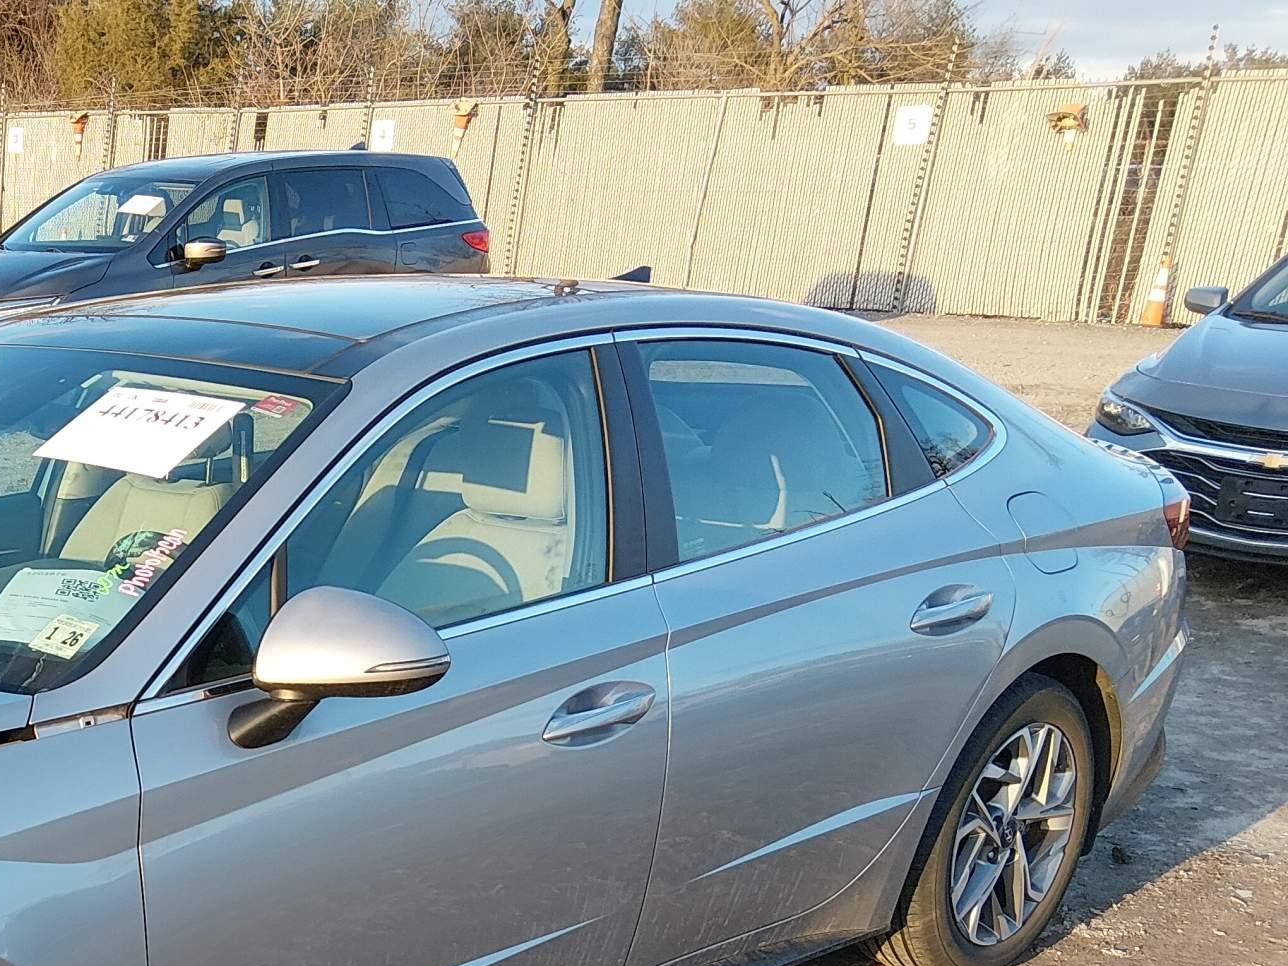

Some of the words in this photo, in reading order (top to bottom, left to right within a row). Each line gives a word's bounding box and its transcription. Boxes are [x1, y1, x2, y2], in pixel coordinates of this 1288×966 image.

[907, 118, 917, 130] 5
[98, 404, 205, 430] 44178413
[44, 625, 60, 641] 1
[60, 630, 84, 648] 26
